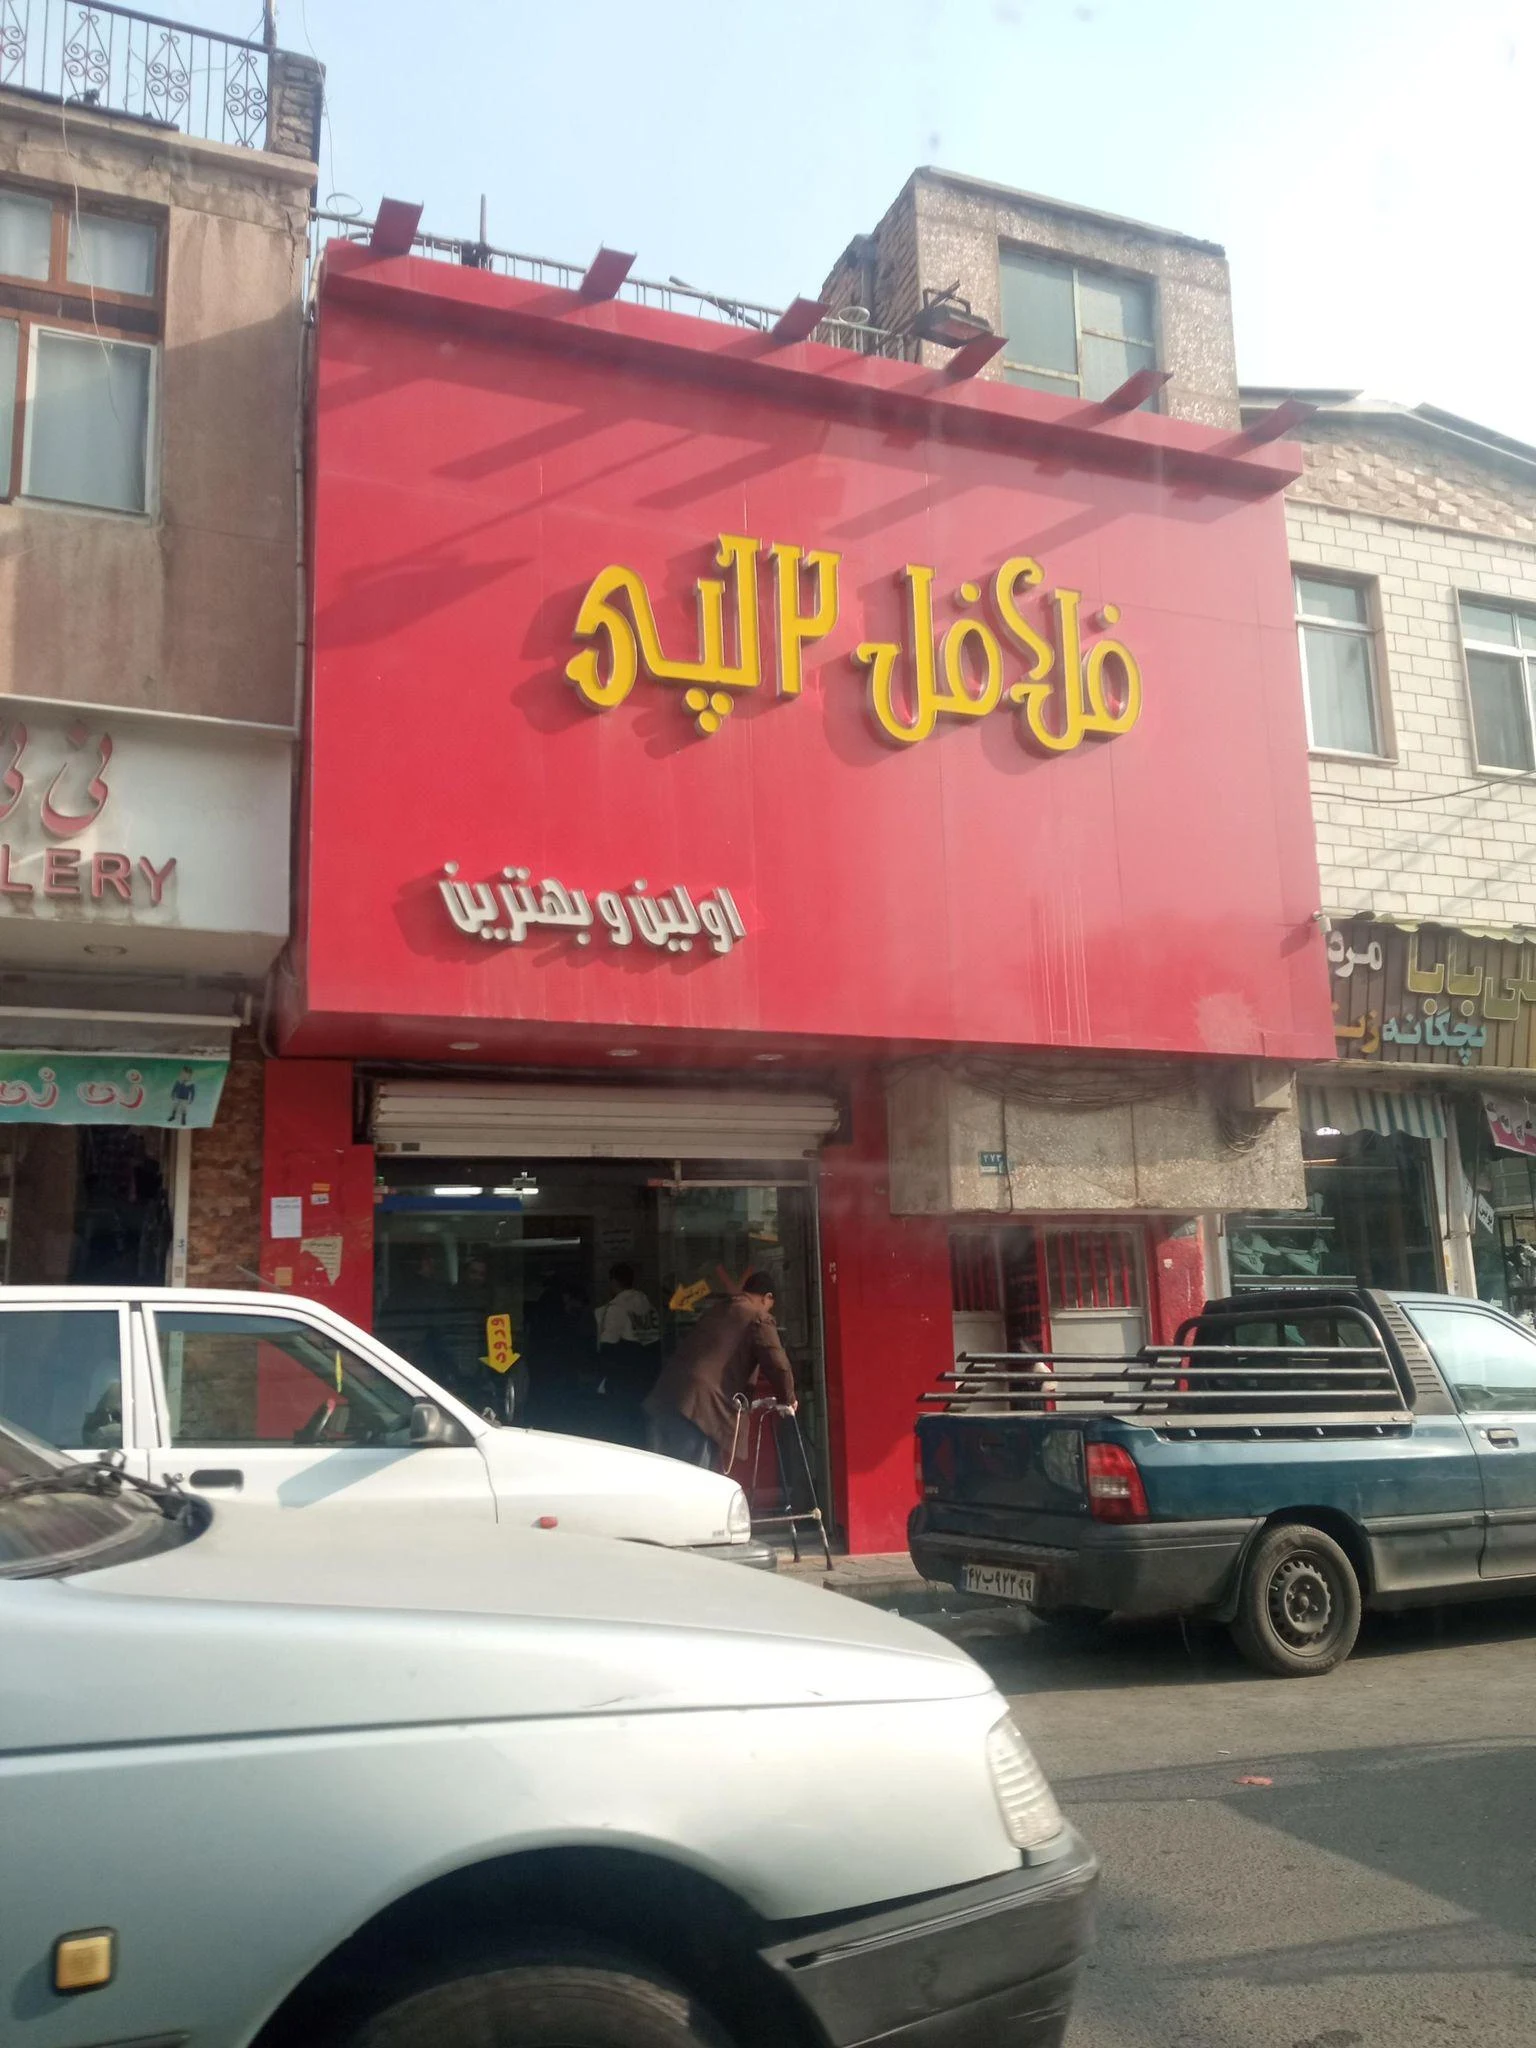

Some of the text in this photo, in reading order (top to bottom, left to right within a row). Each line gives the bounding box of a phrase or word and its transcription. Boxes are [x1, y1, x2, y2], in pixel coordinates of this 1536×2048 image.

[438, 860, 747, 953] اولین و بهترین
